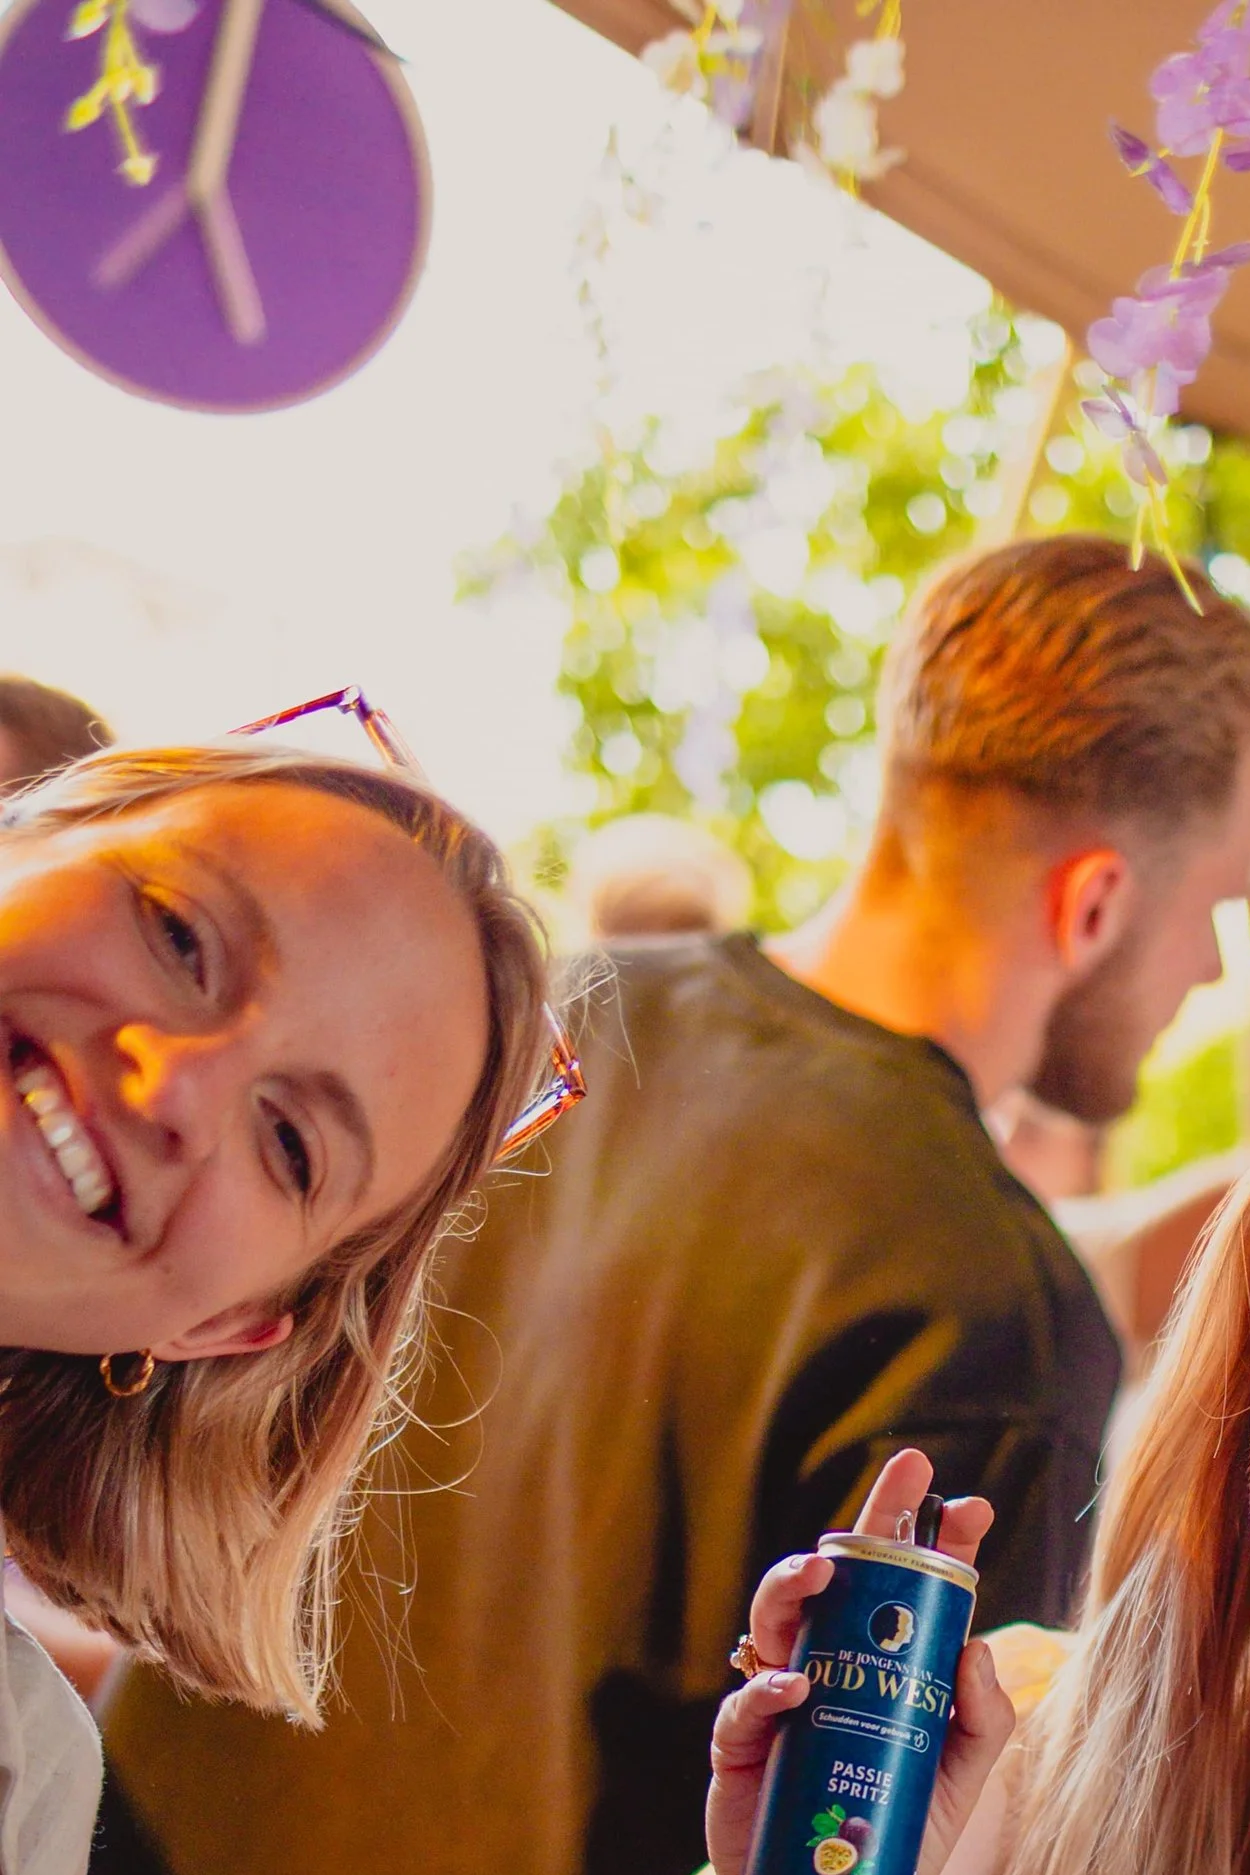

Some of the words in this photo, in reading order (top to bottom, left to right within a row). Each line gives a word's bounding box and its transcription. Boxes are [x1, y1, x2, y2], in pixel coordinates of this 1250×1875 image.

[838, 1650, 855, 1662] DE
[855, 1653, 910, 1674] JONGENS
[911, 1669, 934, 1682] VAN
[804, 1659, 866, 1691] OUD
[877, 1670, 950, 1719] WEST
[819, 1712, 859, 1726] Schudden
[860, 1720, 881, 1731] voor
[832, 1760, 892, 1787] PASSIE
[827, 1778, 889, 1805] SPRITZ
